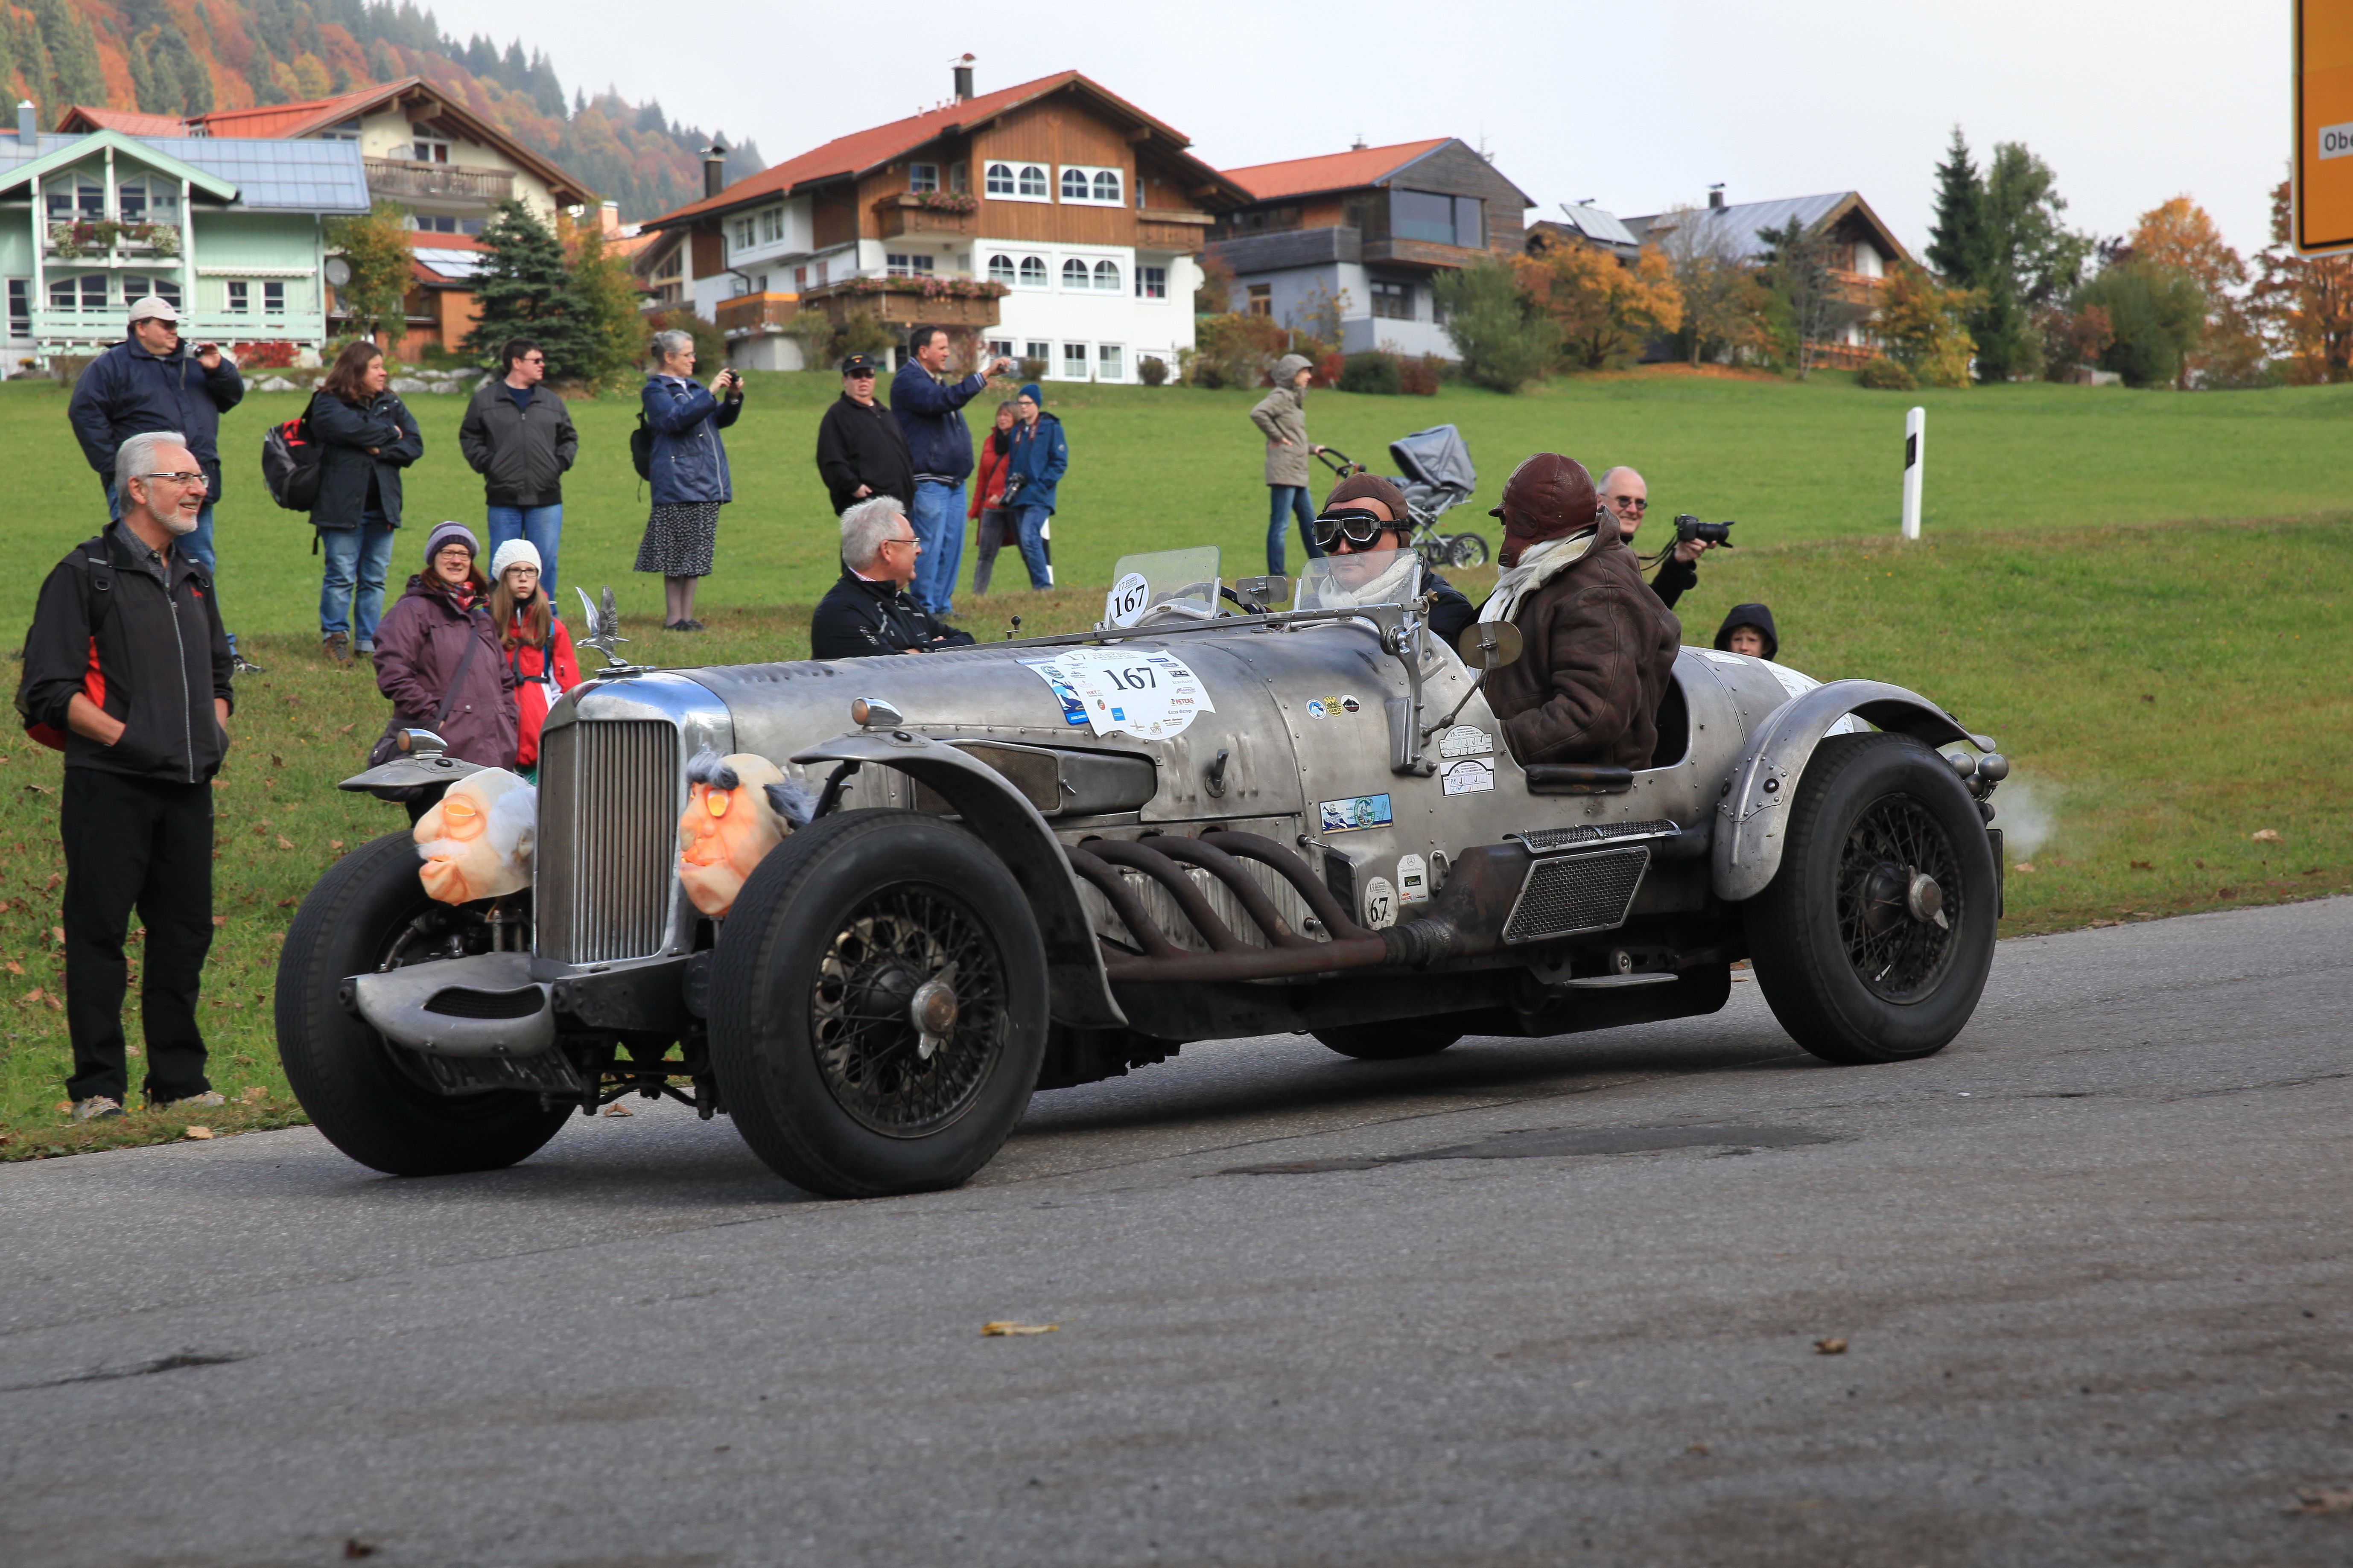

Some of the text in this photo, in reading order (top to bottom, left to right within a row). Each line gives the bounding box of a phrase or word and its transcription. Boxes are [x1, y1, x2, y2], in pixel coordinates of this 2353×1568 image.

[1114, 583, 1145, 618] 167
[1103, 667, 1156, 690] 167
[1370, 897, 1388, 922] 67
